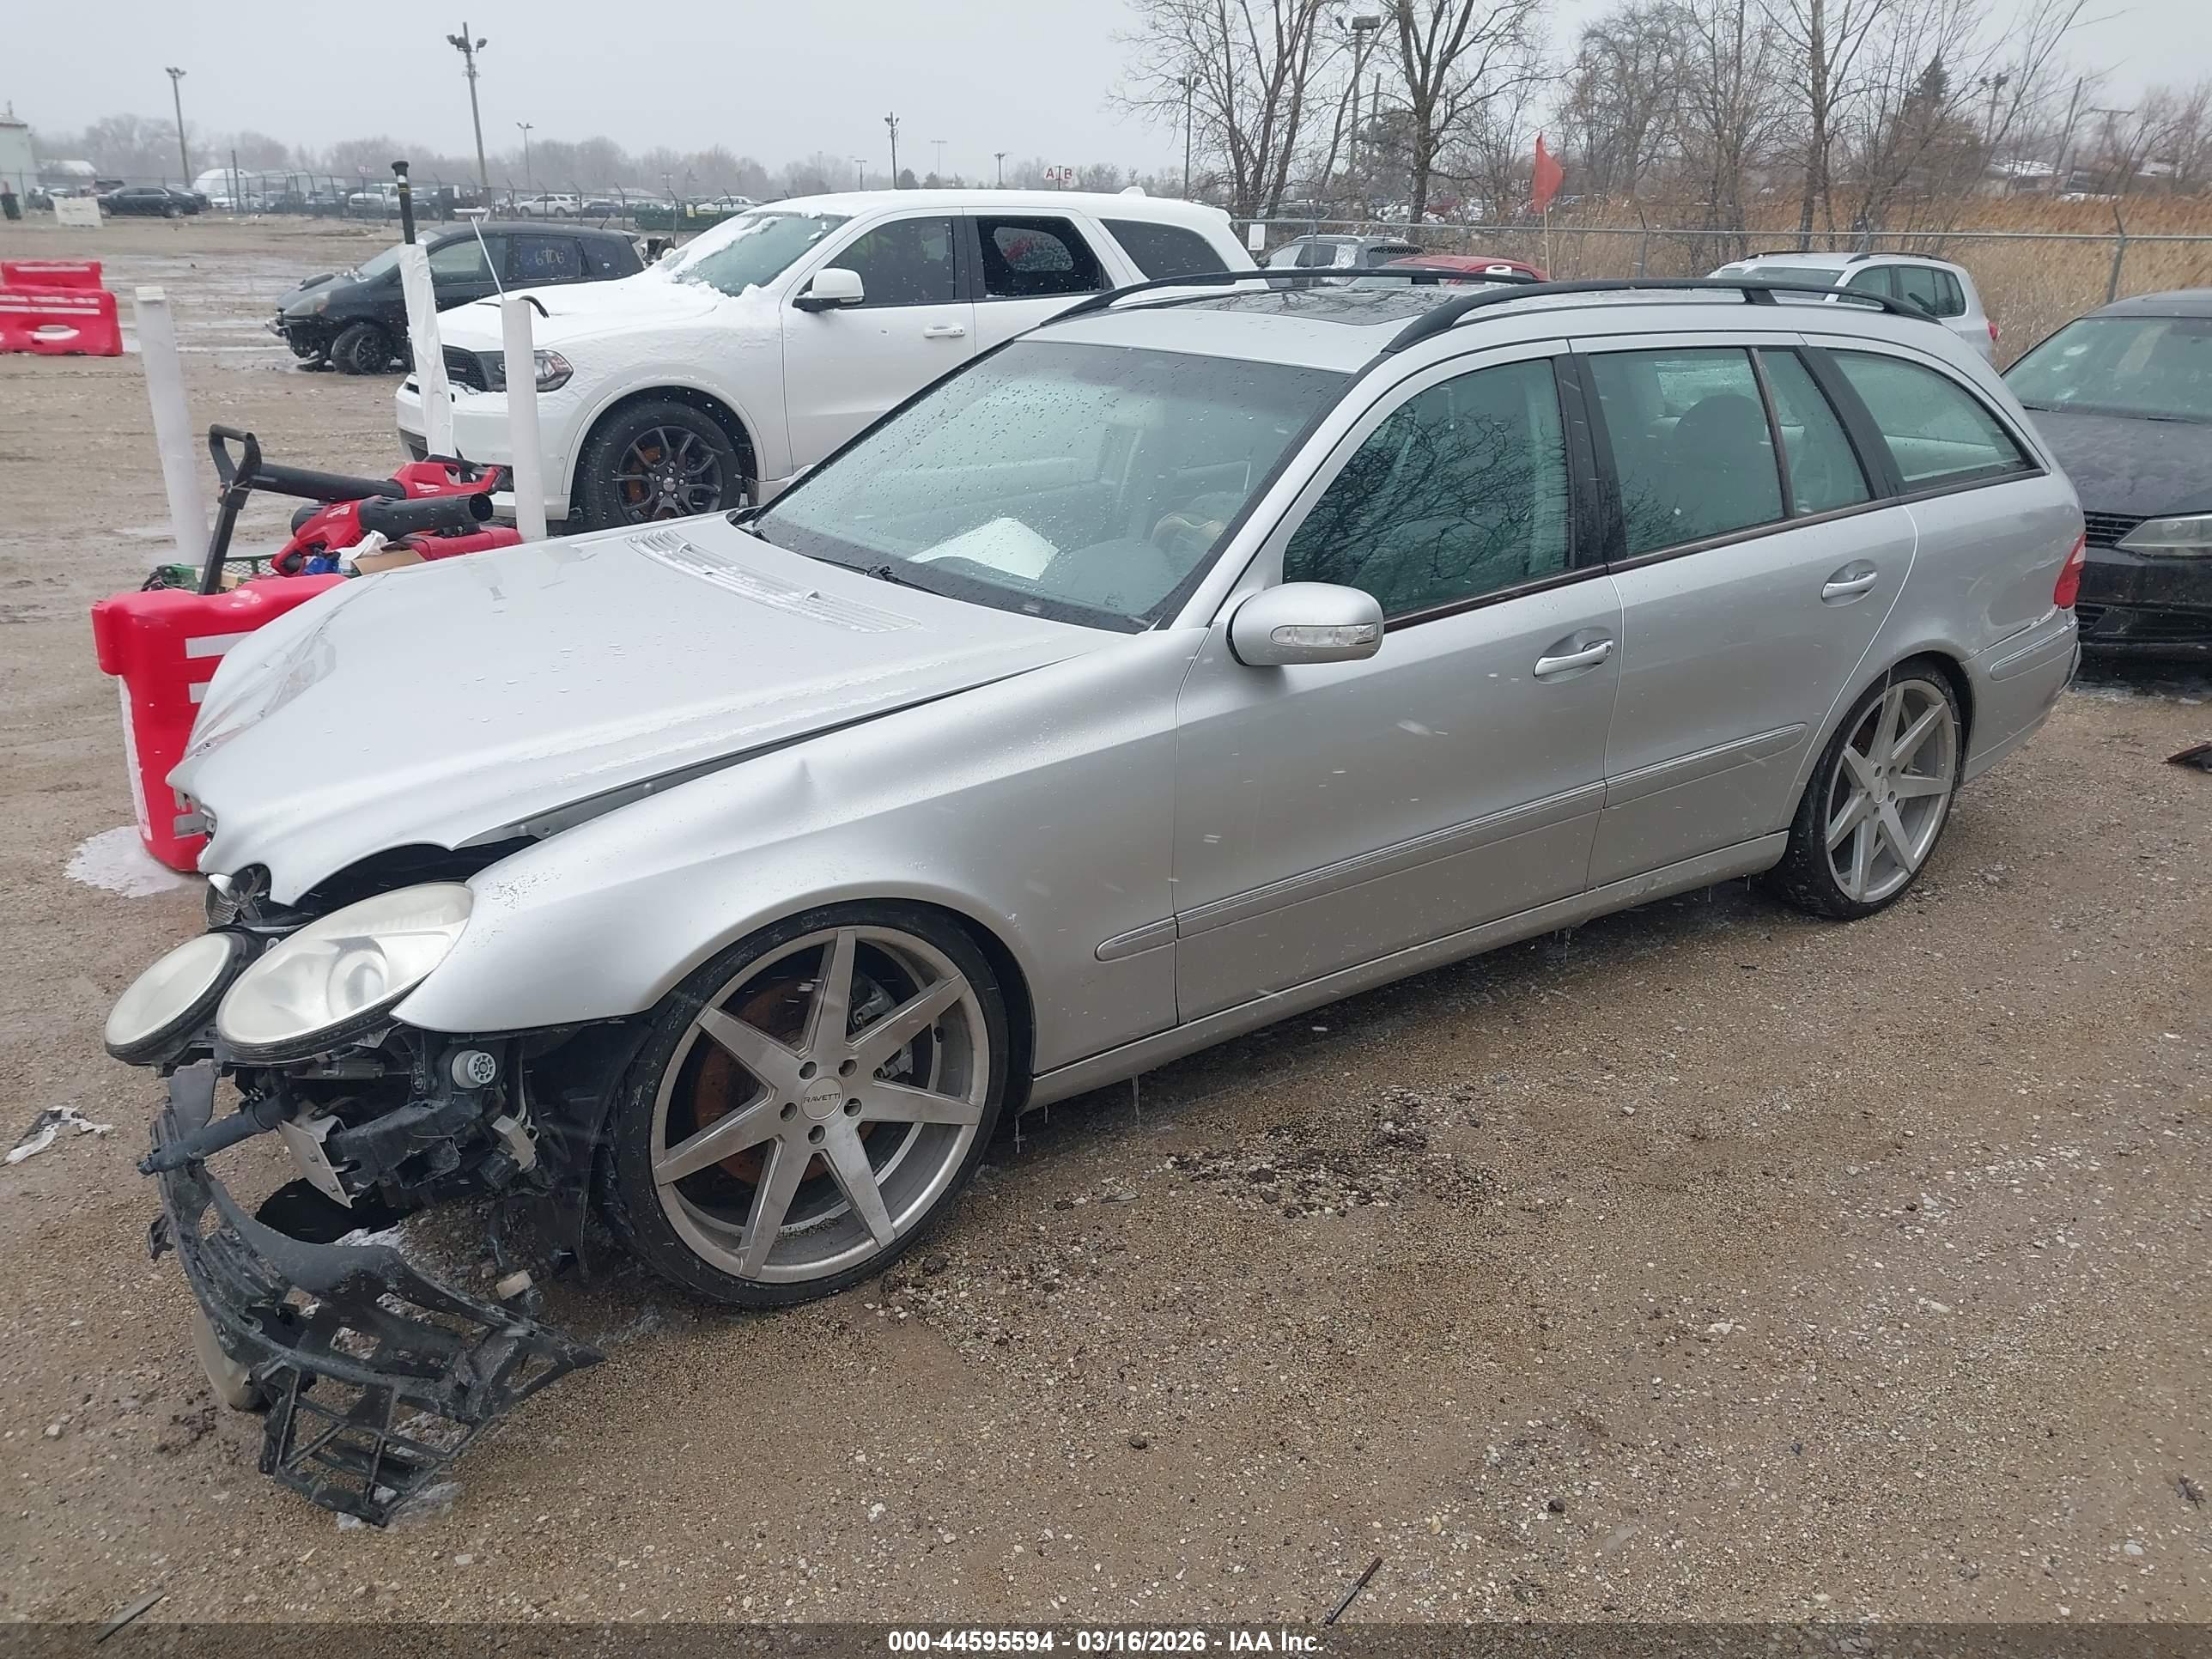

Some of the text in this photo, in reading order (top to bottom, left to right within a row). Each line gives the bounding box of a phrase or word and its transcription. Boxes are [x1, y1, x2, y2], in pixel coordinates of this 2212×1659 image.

[1045, 167, 1054, 179] A
[1064, 167, 1073, 179] B
[804, 1092, 841, 1103] RAVETTI
